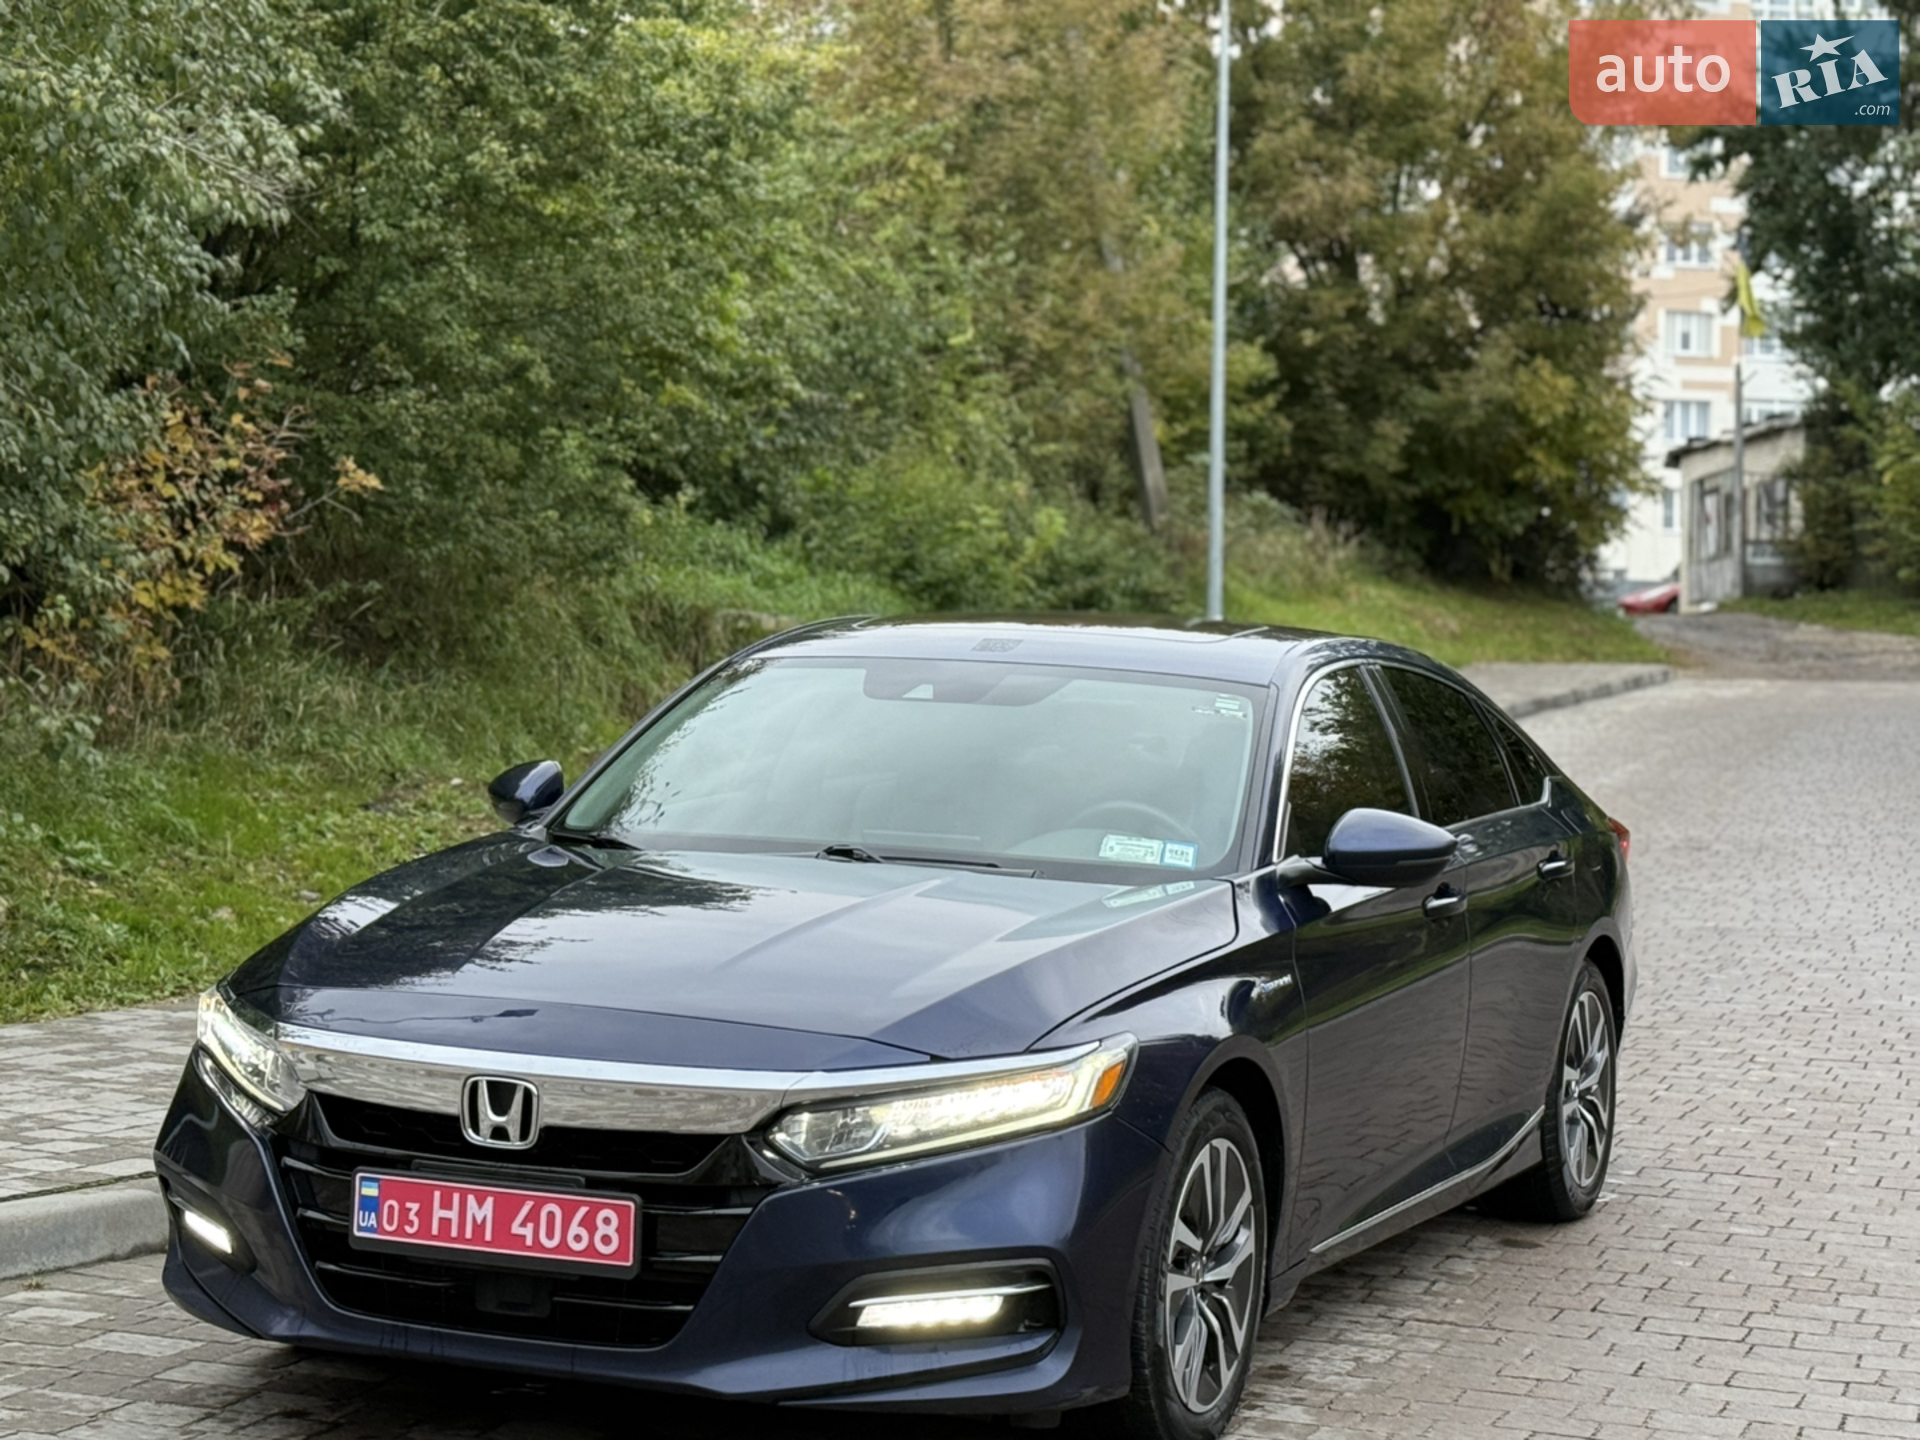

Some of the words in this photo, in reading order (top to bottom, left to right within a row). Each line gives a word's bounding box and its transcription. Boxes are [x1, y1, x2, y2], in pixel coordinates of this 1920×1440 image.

[358, 1210, 378, 1229] UA
[382, 1199, 421, 1235] 03
[431, 1190, 494, 1242] HM
[510, 1200, 620, 1256] 4068
